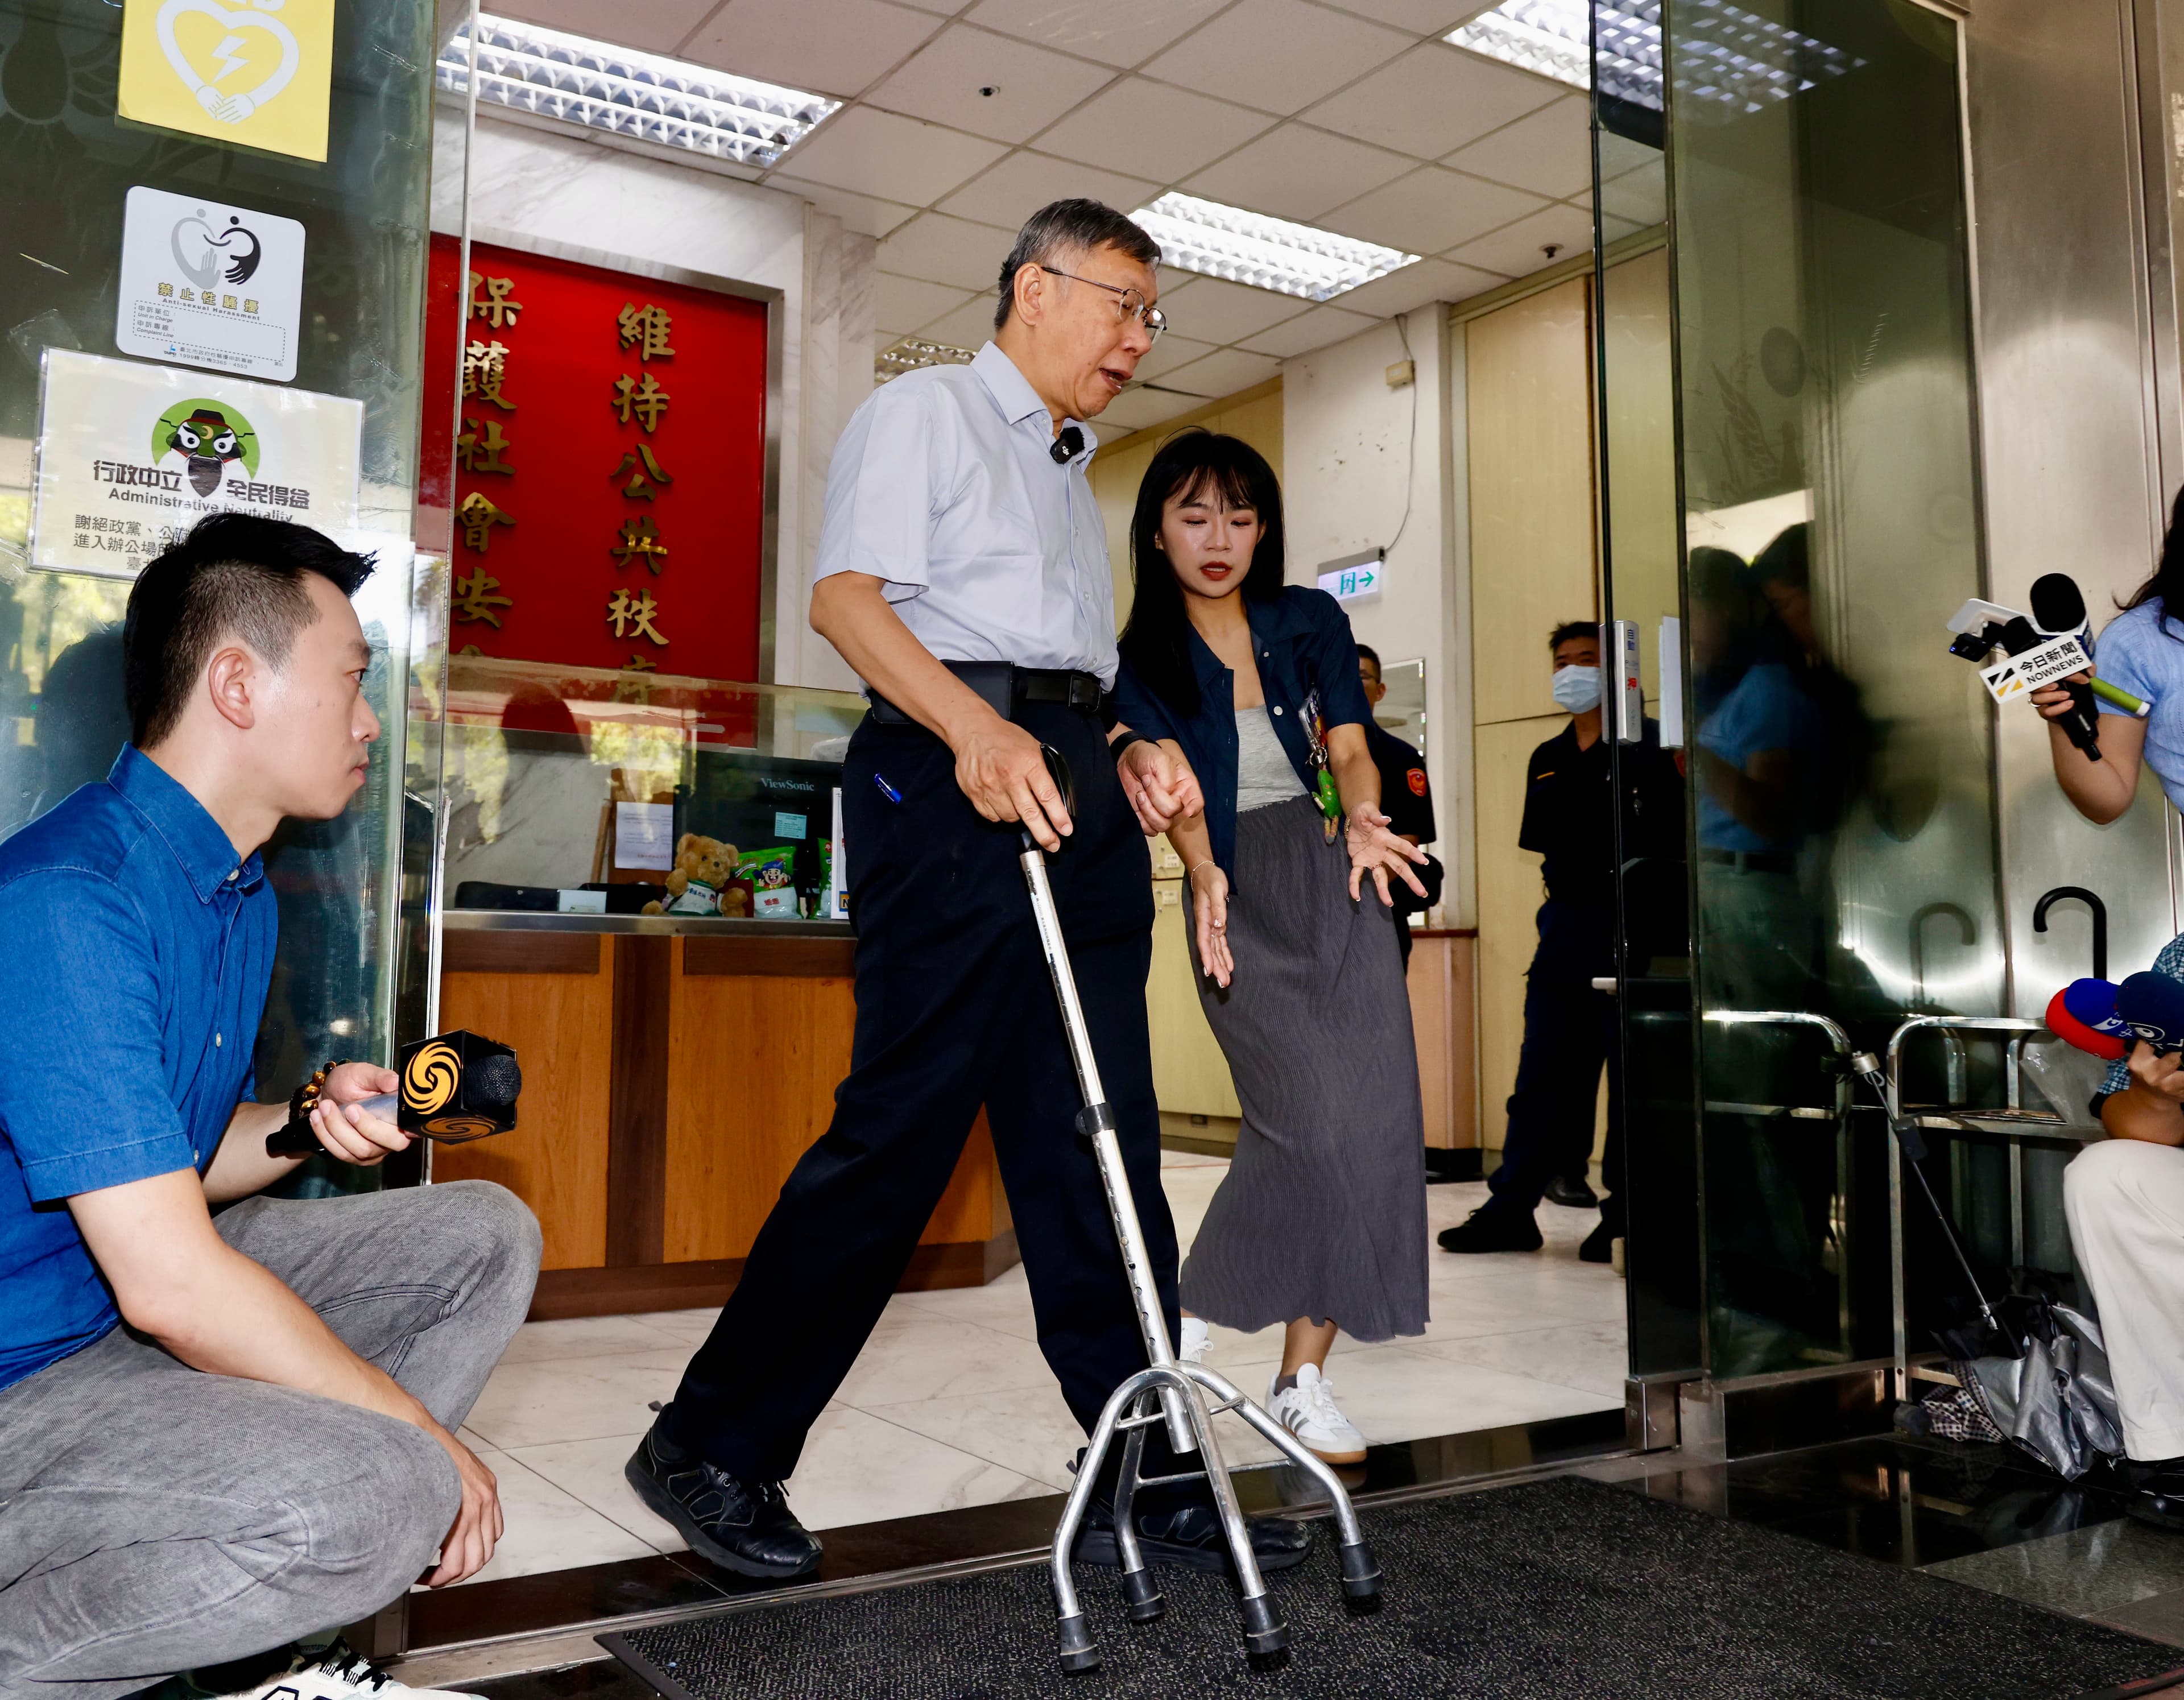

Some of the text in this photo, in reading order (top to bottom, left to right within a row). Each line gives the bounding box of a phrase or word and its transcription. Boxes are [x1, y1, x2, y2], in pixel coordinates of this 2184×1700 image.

[158, 282, 259, 313] 禁止性騷擾
[163, 298, 260, 321] Anti-sexual Harassment
[136, 327, 162, 337] Complaint
[450, 270, 523, 656] 保護社會安
[93, 460, 310, 510] 行政中立 全民得益
[109, 487, 219, 512] Administrative
[2020, 642, 2078, 672] 今日新聞
[2026, 655, 2084, 684] NOWNEWS
[761, 777, 815, 792] ViewSonic
